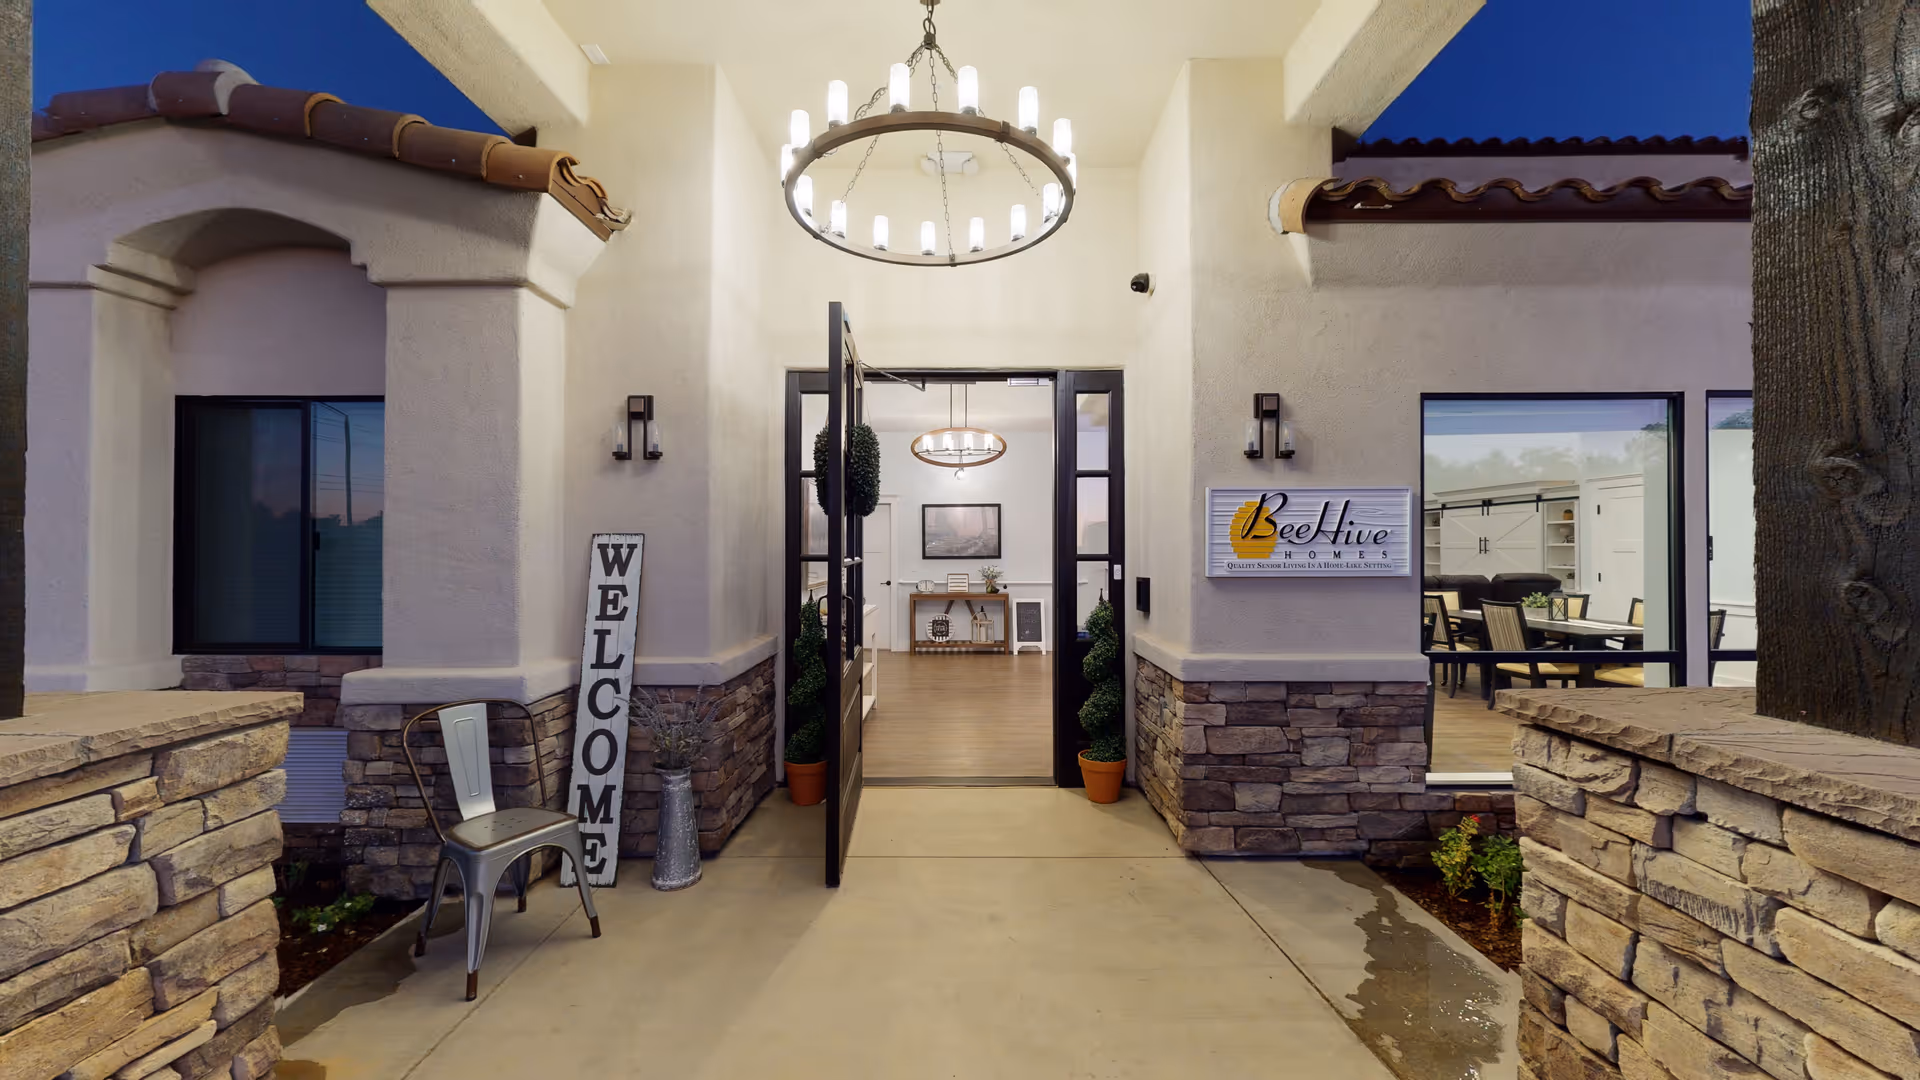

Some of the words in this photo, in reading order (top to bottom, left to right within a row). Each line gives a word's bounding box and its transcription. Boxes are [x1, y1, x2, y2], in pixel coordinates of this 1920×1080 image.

[1240, 492, 1388, 545] BeeHive
[1227, 562, 1256, 570] QUALITY
[1284, 550, 1388, 559] HOMES
[571, 543, 638, 875] WELCOME
